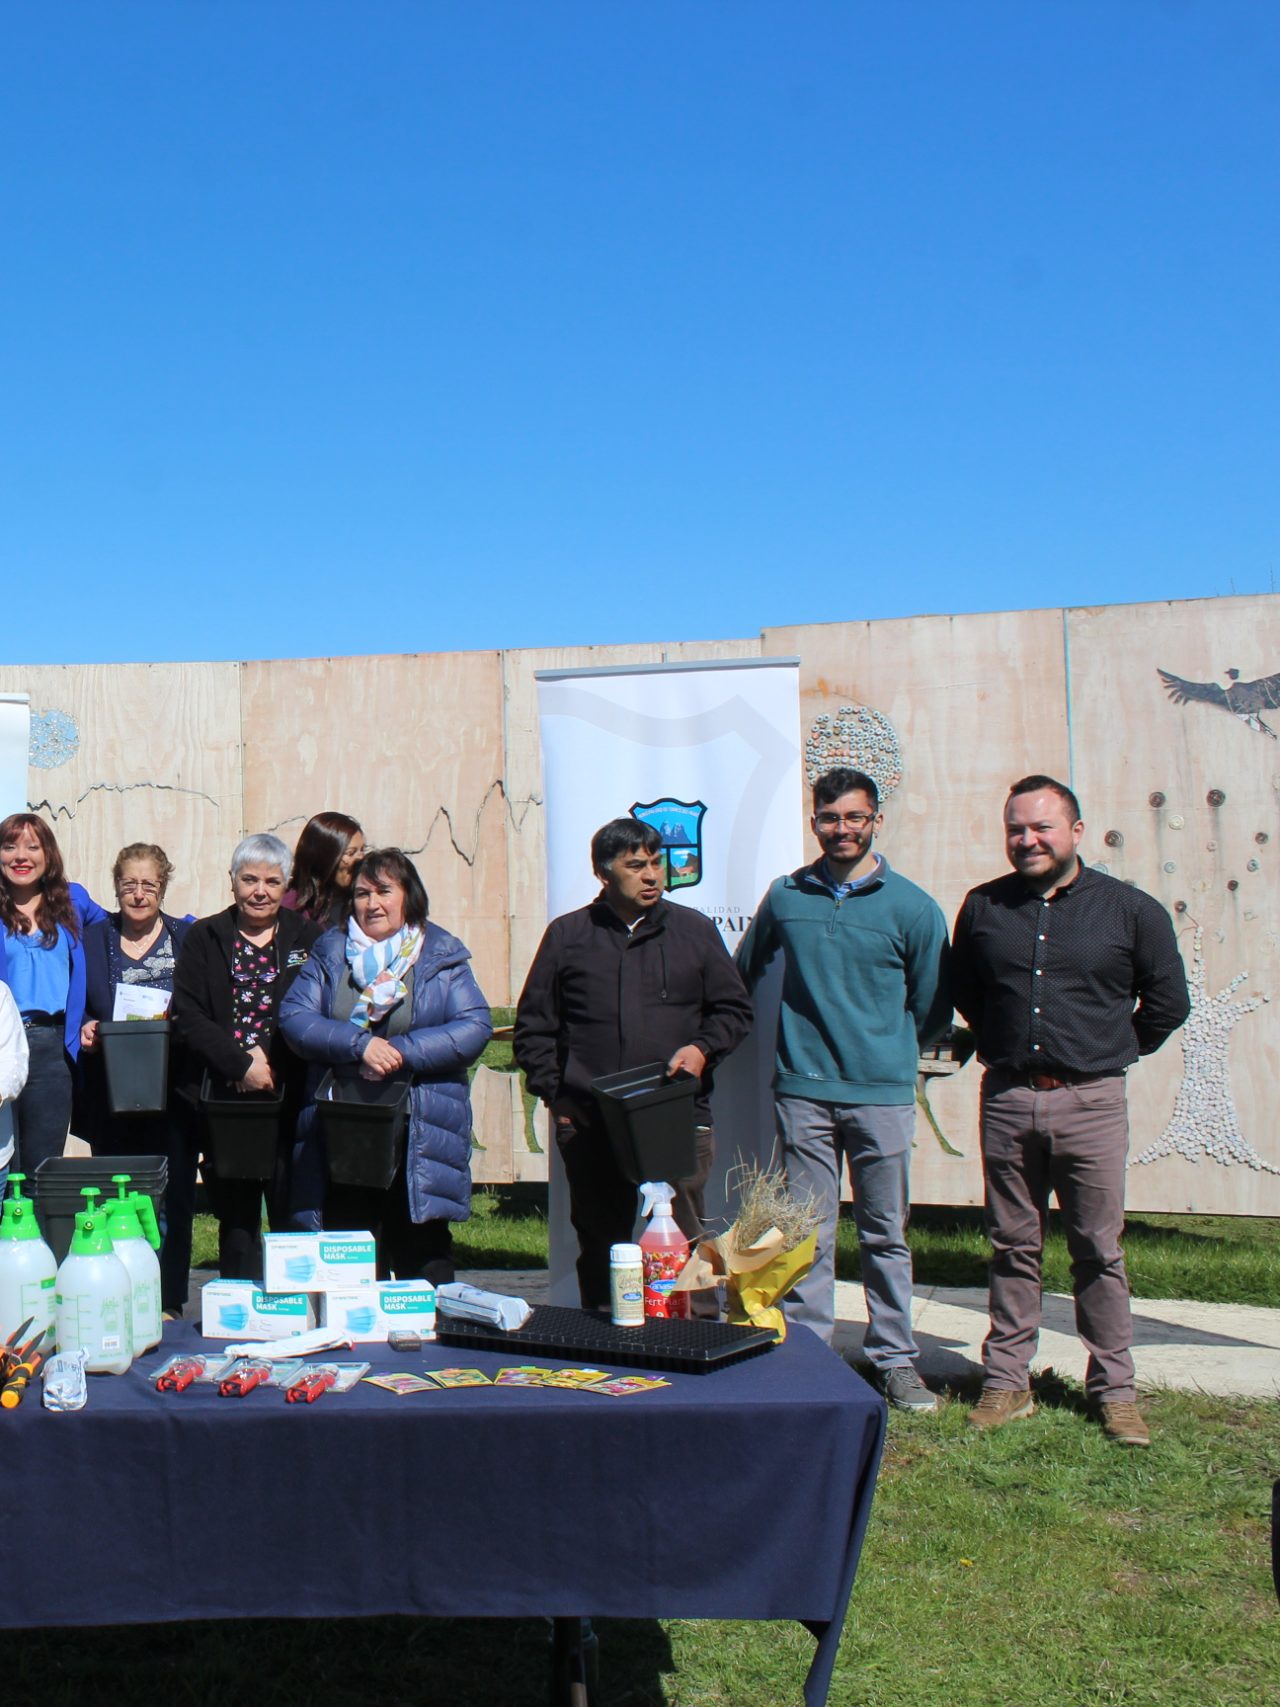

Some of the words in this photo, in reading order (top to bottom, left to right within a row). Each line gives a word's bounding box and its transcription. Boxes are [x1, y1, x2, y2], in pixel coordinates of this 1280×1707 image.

[323, 1244, 372, 1253] DISPOSABLE
[256, 1296, 303, 1305] DISPOSABLE
[384, 1294, 432, 1303] DISPOSABLE
